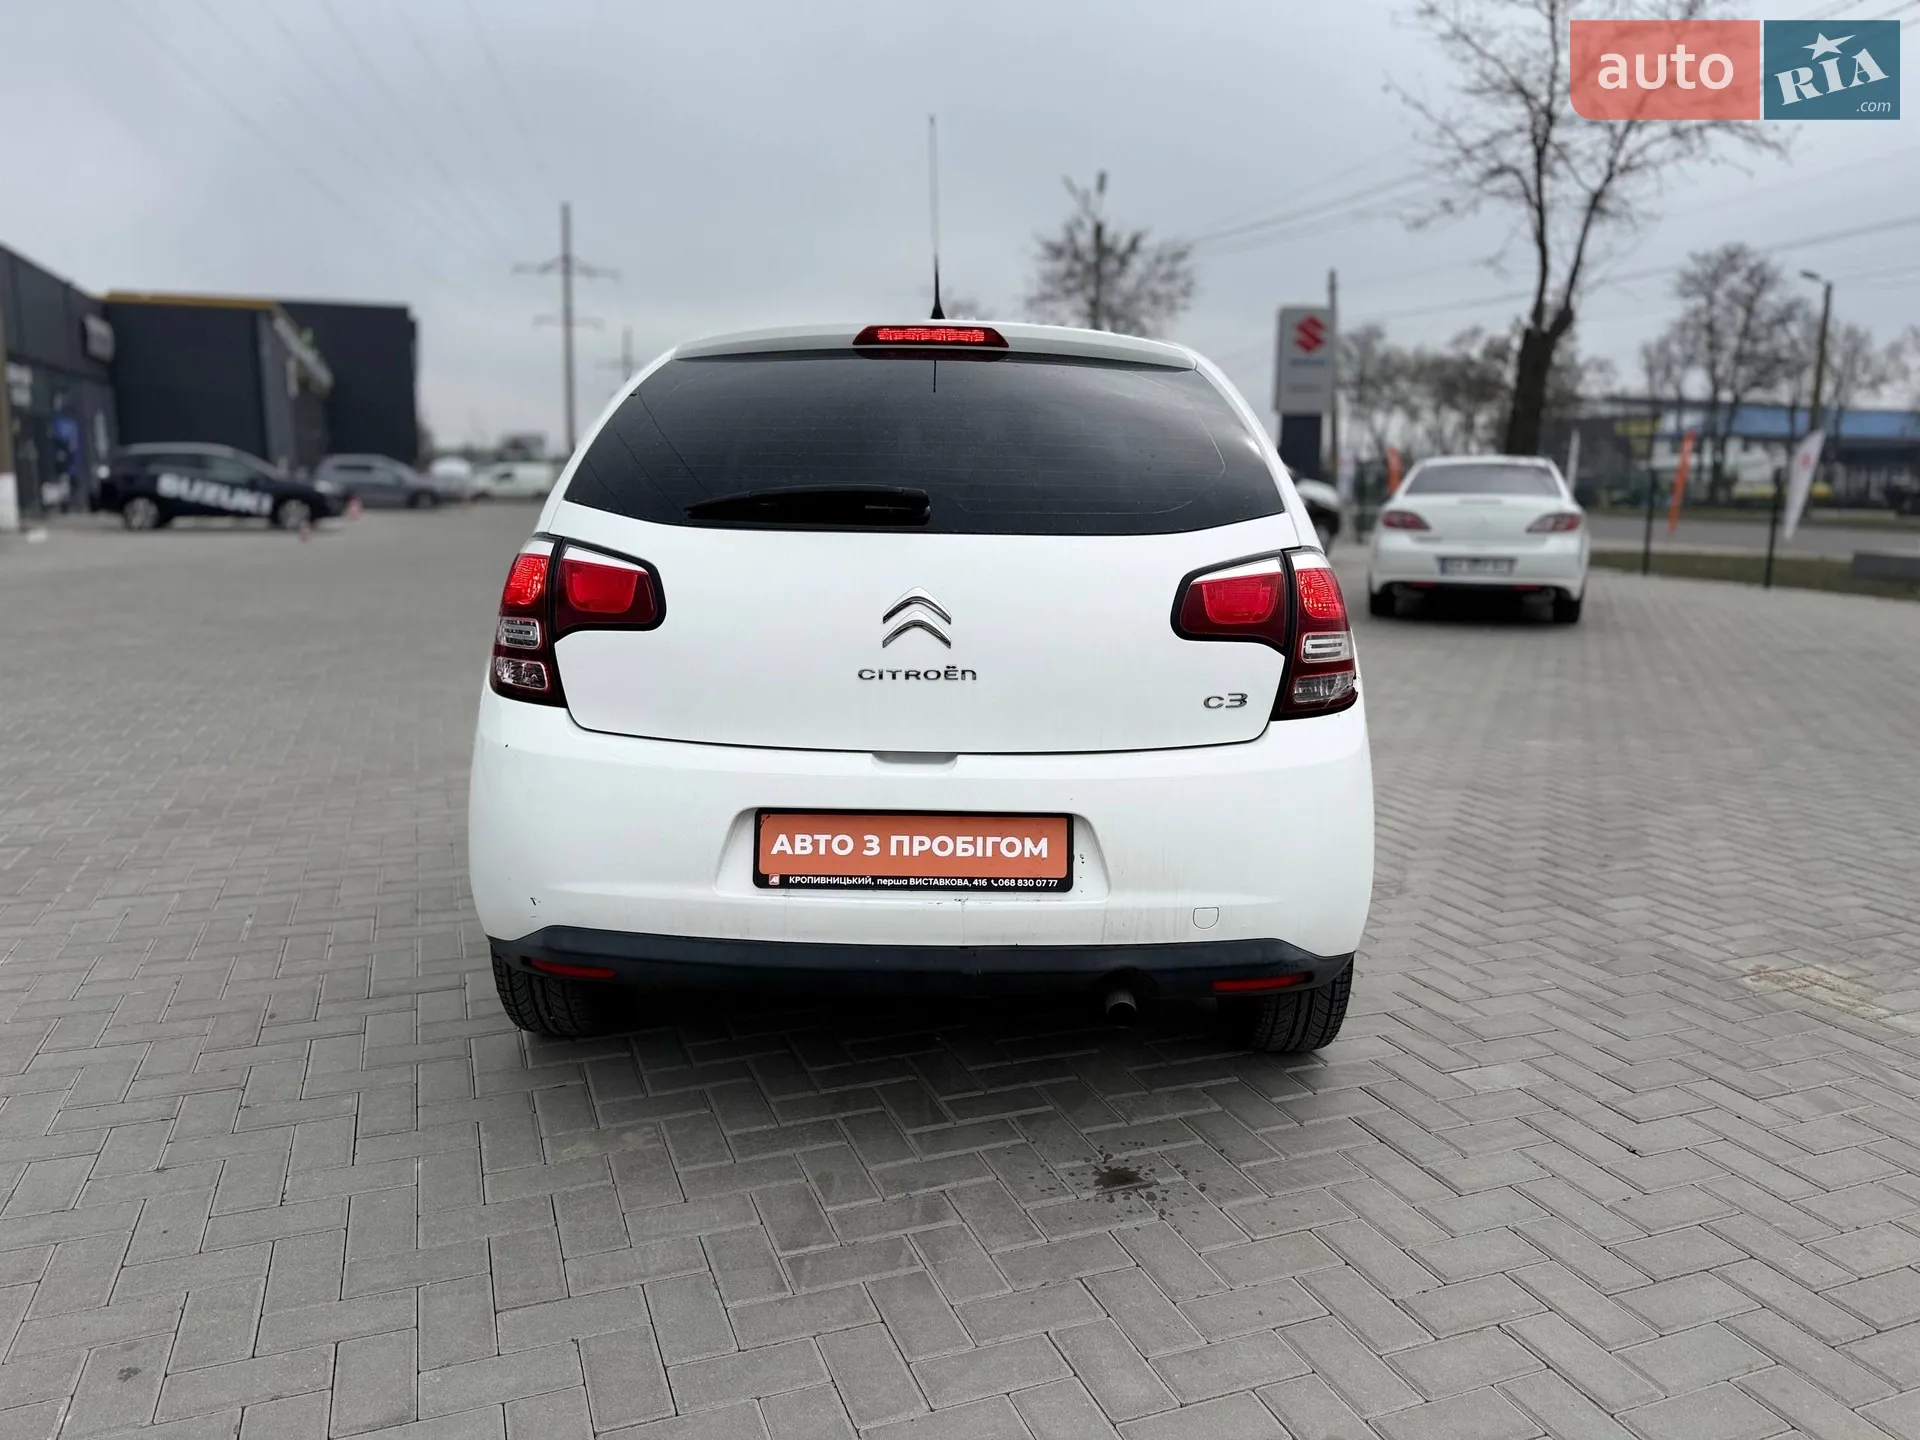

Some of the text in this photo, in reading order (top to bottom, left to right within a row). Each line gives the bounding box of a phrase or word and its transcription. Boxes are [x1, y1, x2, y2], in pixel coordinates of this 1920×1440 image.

[1203, 692, 1248, 709] C3
[770, 833, 854, 856] АВТО
[889, 835, 1049, 858] ПРОБІГОМ
[789, 876, 874, 887] КРОПИВНИЦЬКИЙ,
[877, 878, 908, 887] перша
[909, 878, 971, 888] ВИСТАВКОВА,
[998, 879, 1016, 887] 068
[1017, 879, 1034, 888] 830
[1036, 880, 1047, 888] 07
[1048, 880, 1058, 888] 77
